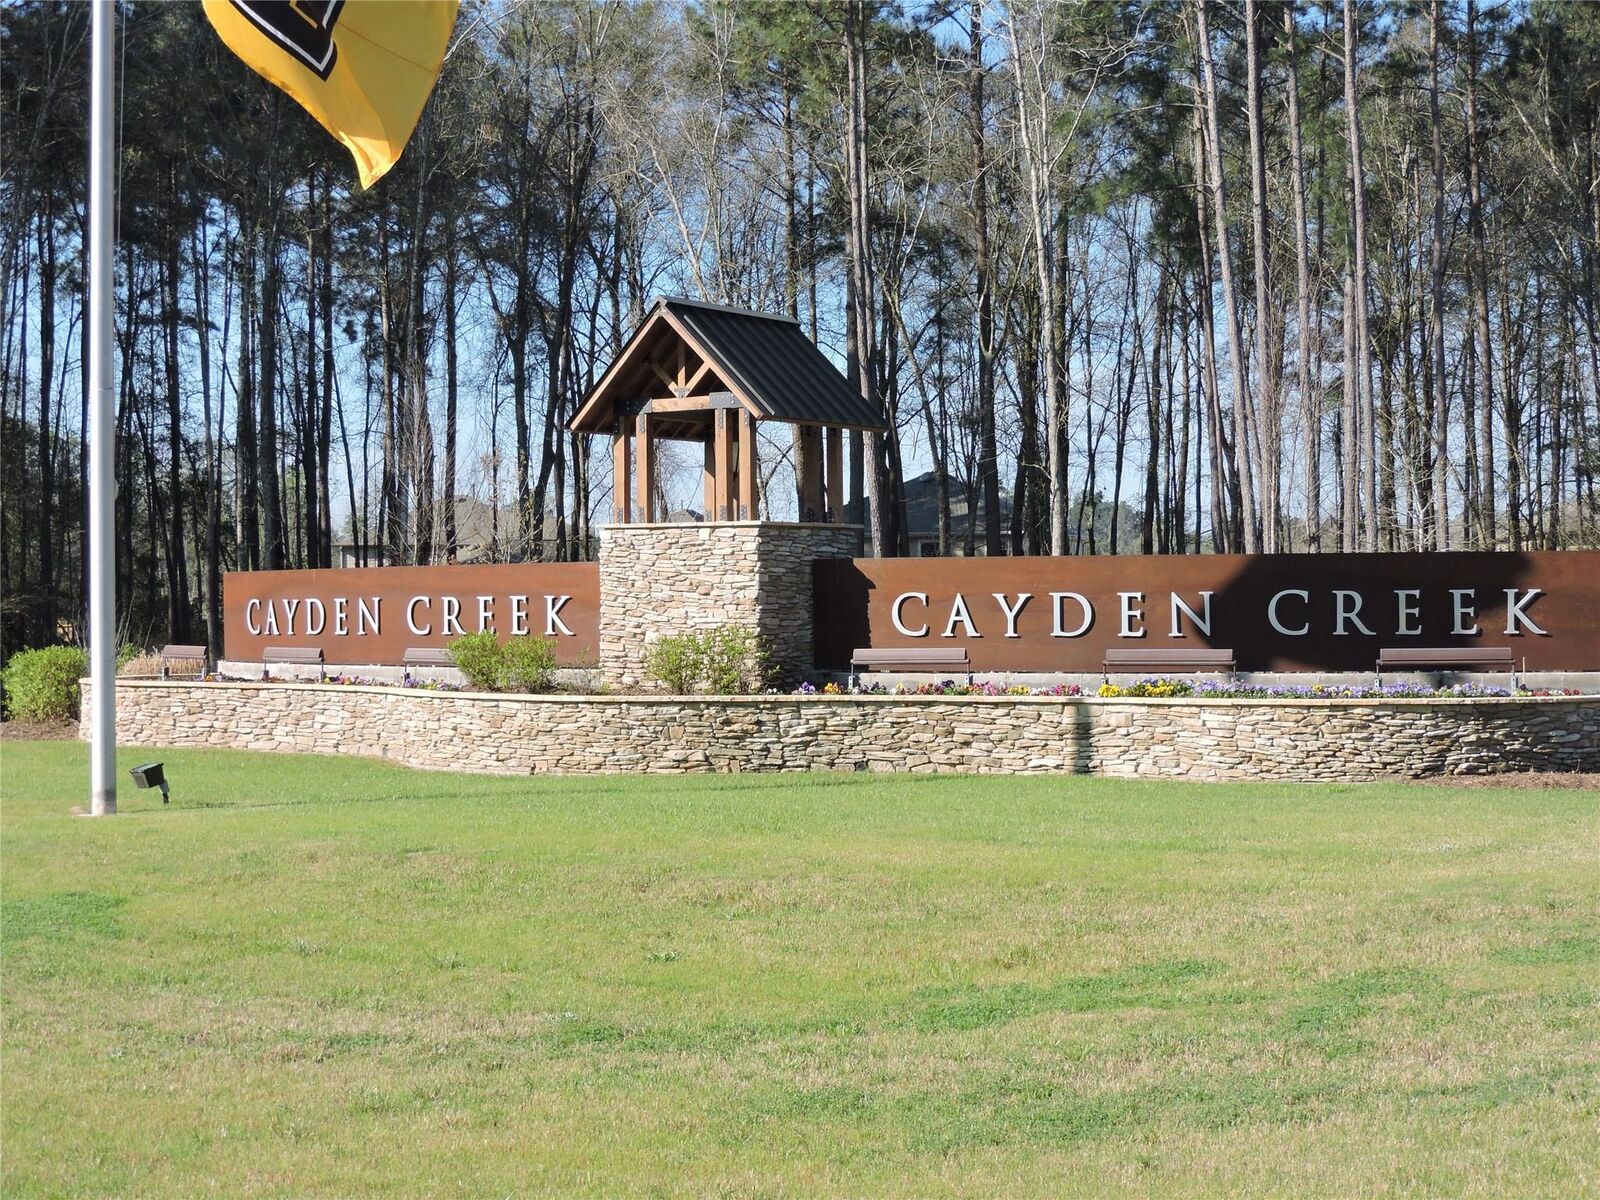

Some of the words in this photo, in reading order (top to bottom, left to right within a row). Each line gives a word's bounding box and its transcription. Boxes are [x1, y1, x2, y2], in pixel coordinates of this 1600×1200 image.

[246, 597, 382, 635] CAYDEN
[406, 595, 575, 635] CREEK
[891, 590, 1214, 638] CAYDEN
[1267, 588, 1548, 636] CREEK
